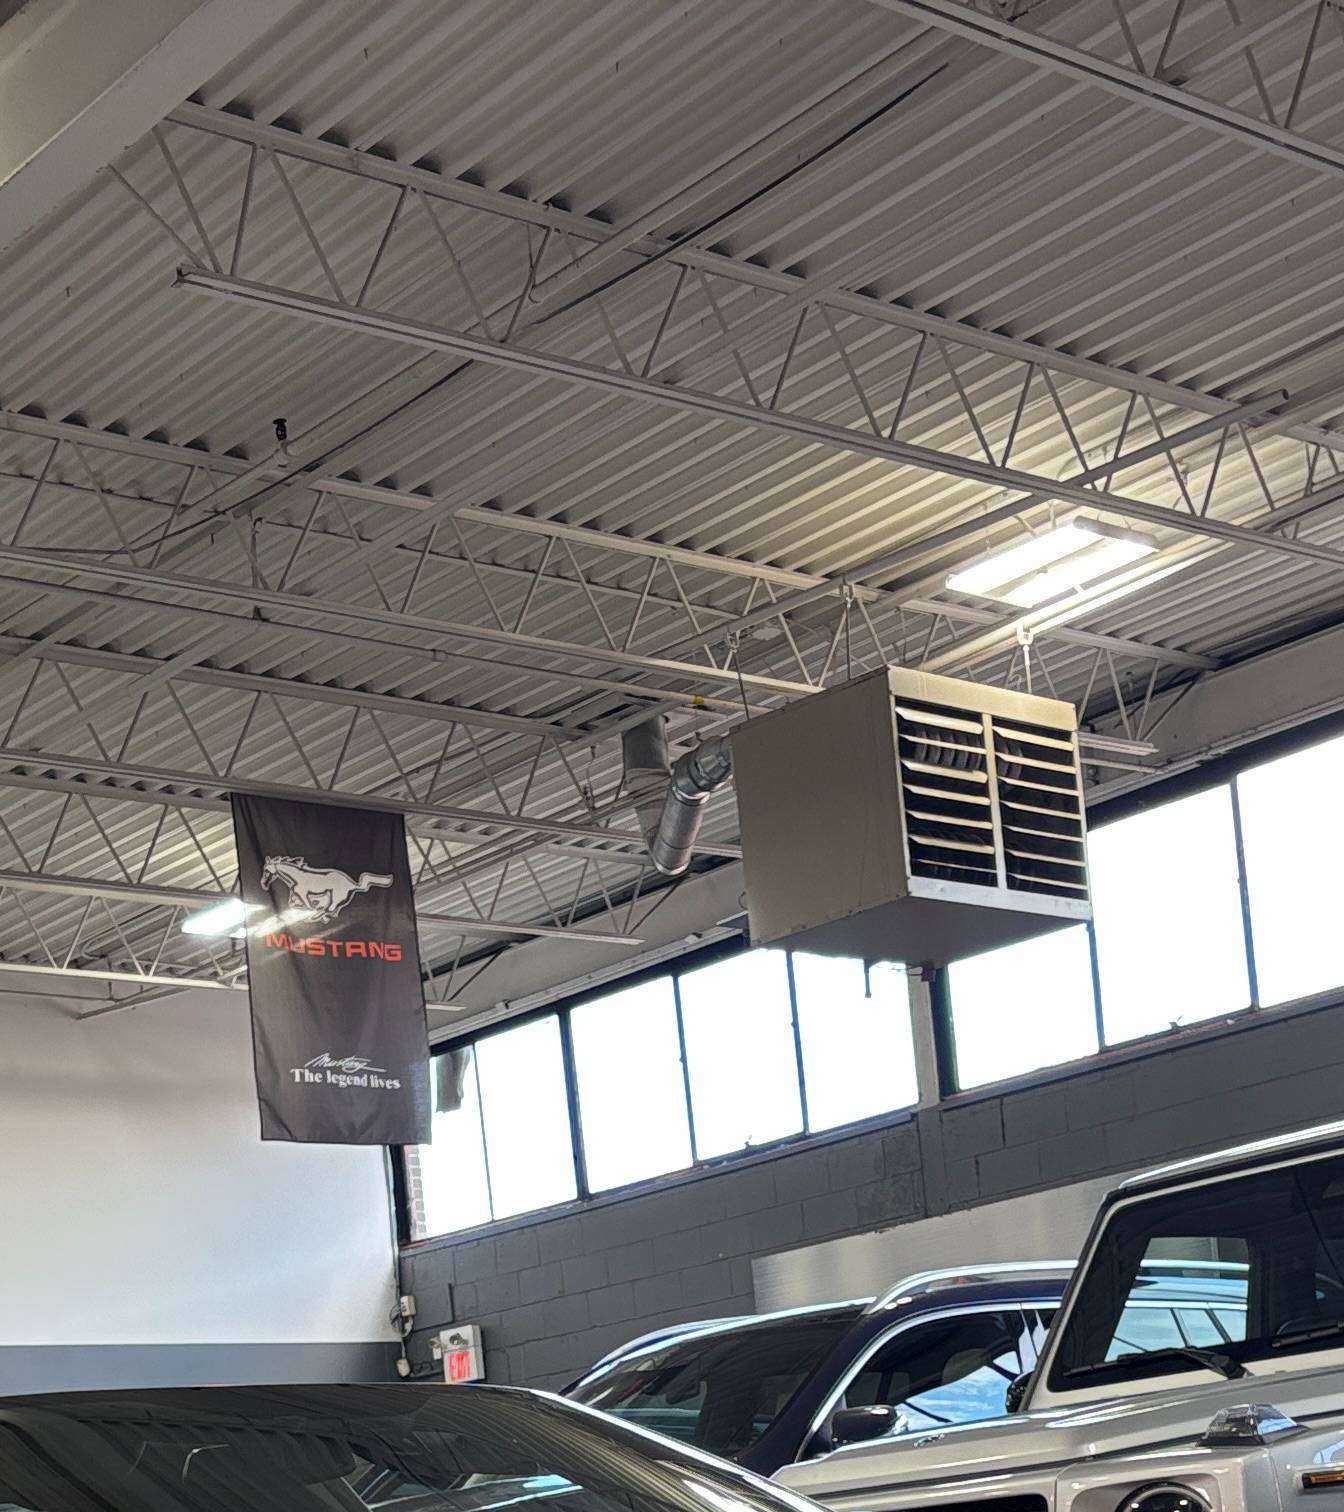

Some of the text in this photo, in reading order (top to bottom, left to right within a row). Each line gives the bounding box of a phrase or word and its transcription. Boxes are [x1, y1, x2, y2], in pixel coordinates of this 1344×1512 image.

[266, 933, 402, 962] MUSTANG
[304, 1052, 387, 1073] Mustang
[289, 1068, 401, 1089] The legend lives
